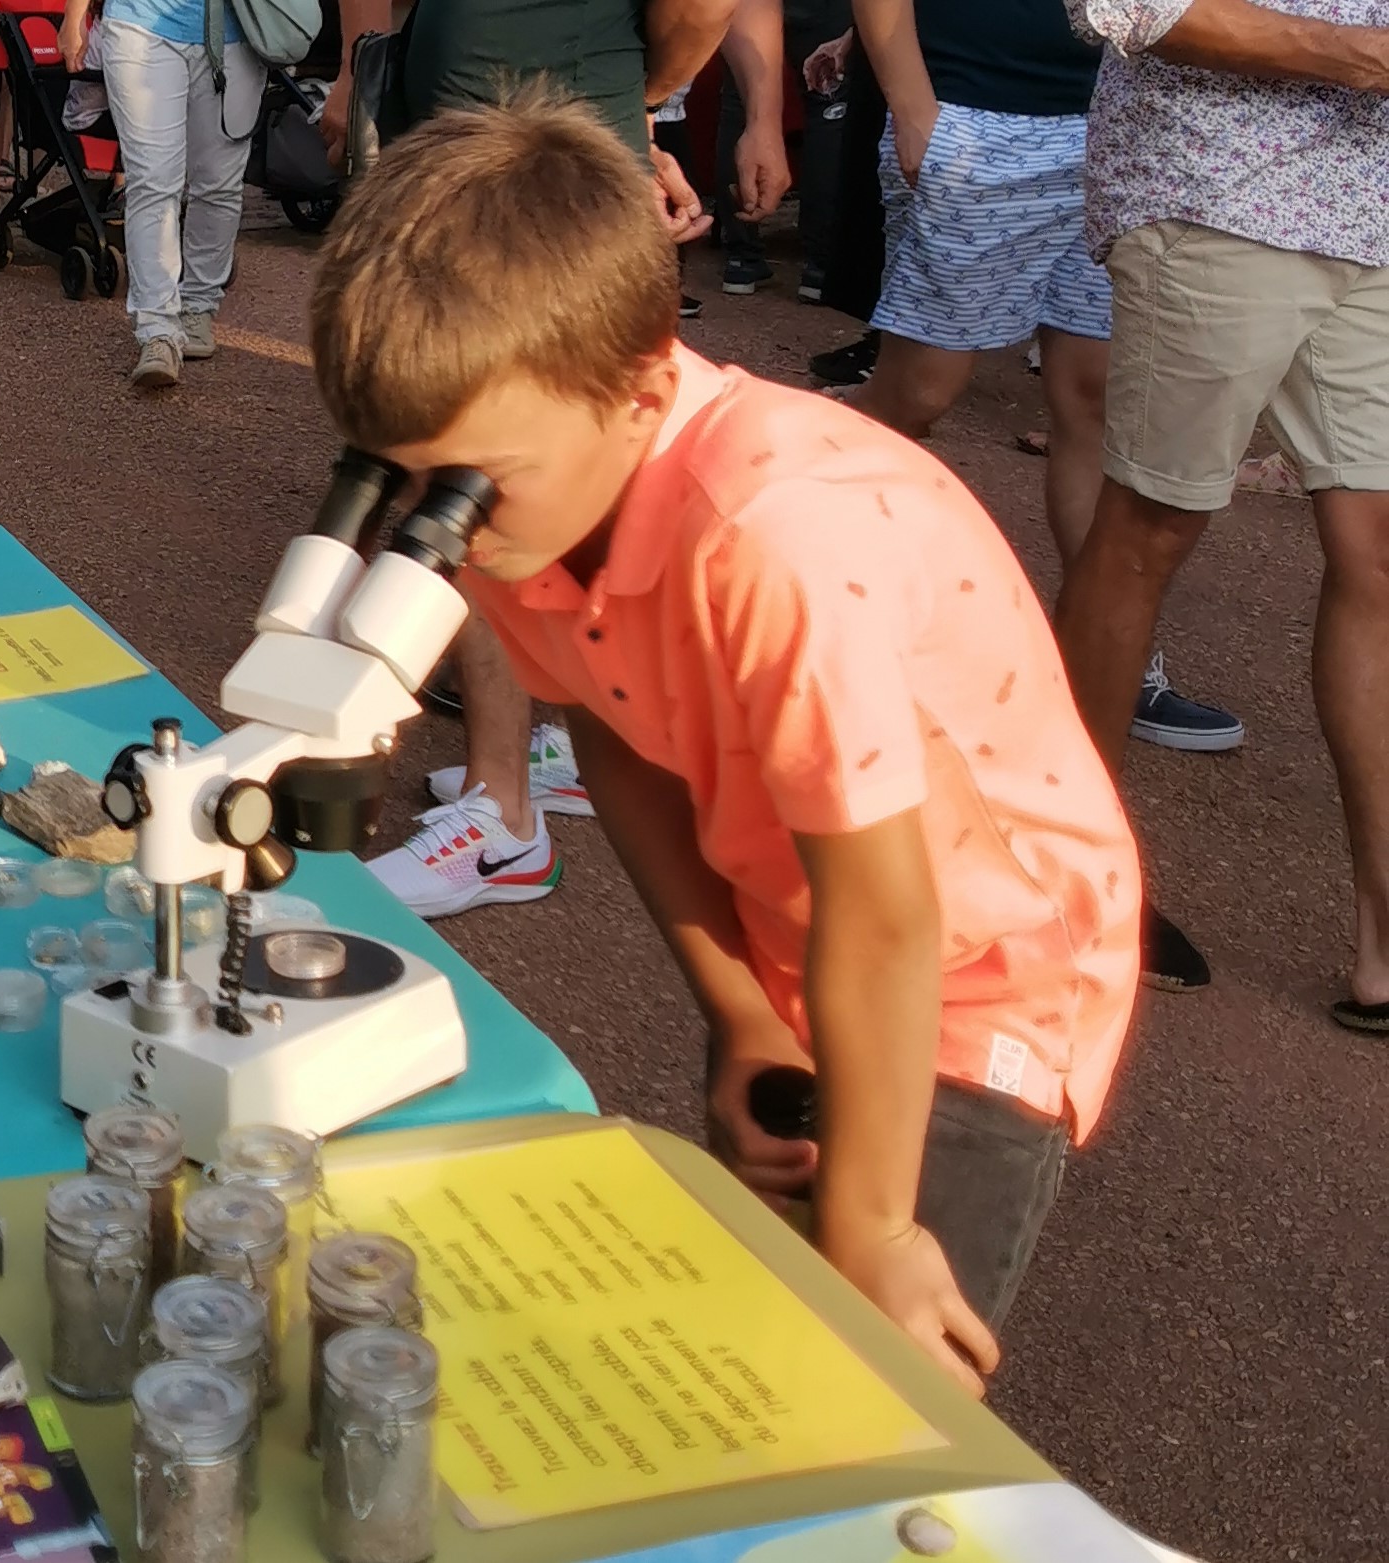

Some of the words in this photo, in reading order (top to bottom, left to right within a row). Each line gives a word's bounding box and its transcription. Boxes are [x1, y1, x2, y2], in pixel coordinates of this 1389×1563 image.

[618, 1326, 657, 1352] pas
[648, 1317, 676, 1337] de
[466, 1358, 508, 1397] sable
[639, 1354, 681, 1388] vient
[668, 1339, 757, 1423] département
[497, 1398, 522, 1416] le
[577, 1394, 608, 1422] lieu
[627, 1381, 659, 1406] ces
[675, 1388, 701, 1408] ne
[511, 1366, 607, 1467] correspondant
[647, 1408, 699, 1451] Parmi
[686, 1410, 745, 1454] lequel
[512, 1416, 567, 1475] Trouvez
[601, 1422, 658, 1476] chaque
[749, 1425, 779, 1445] du
[454, 1422, 517, 1493] Trouvez
